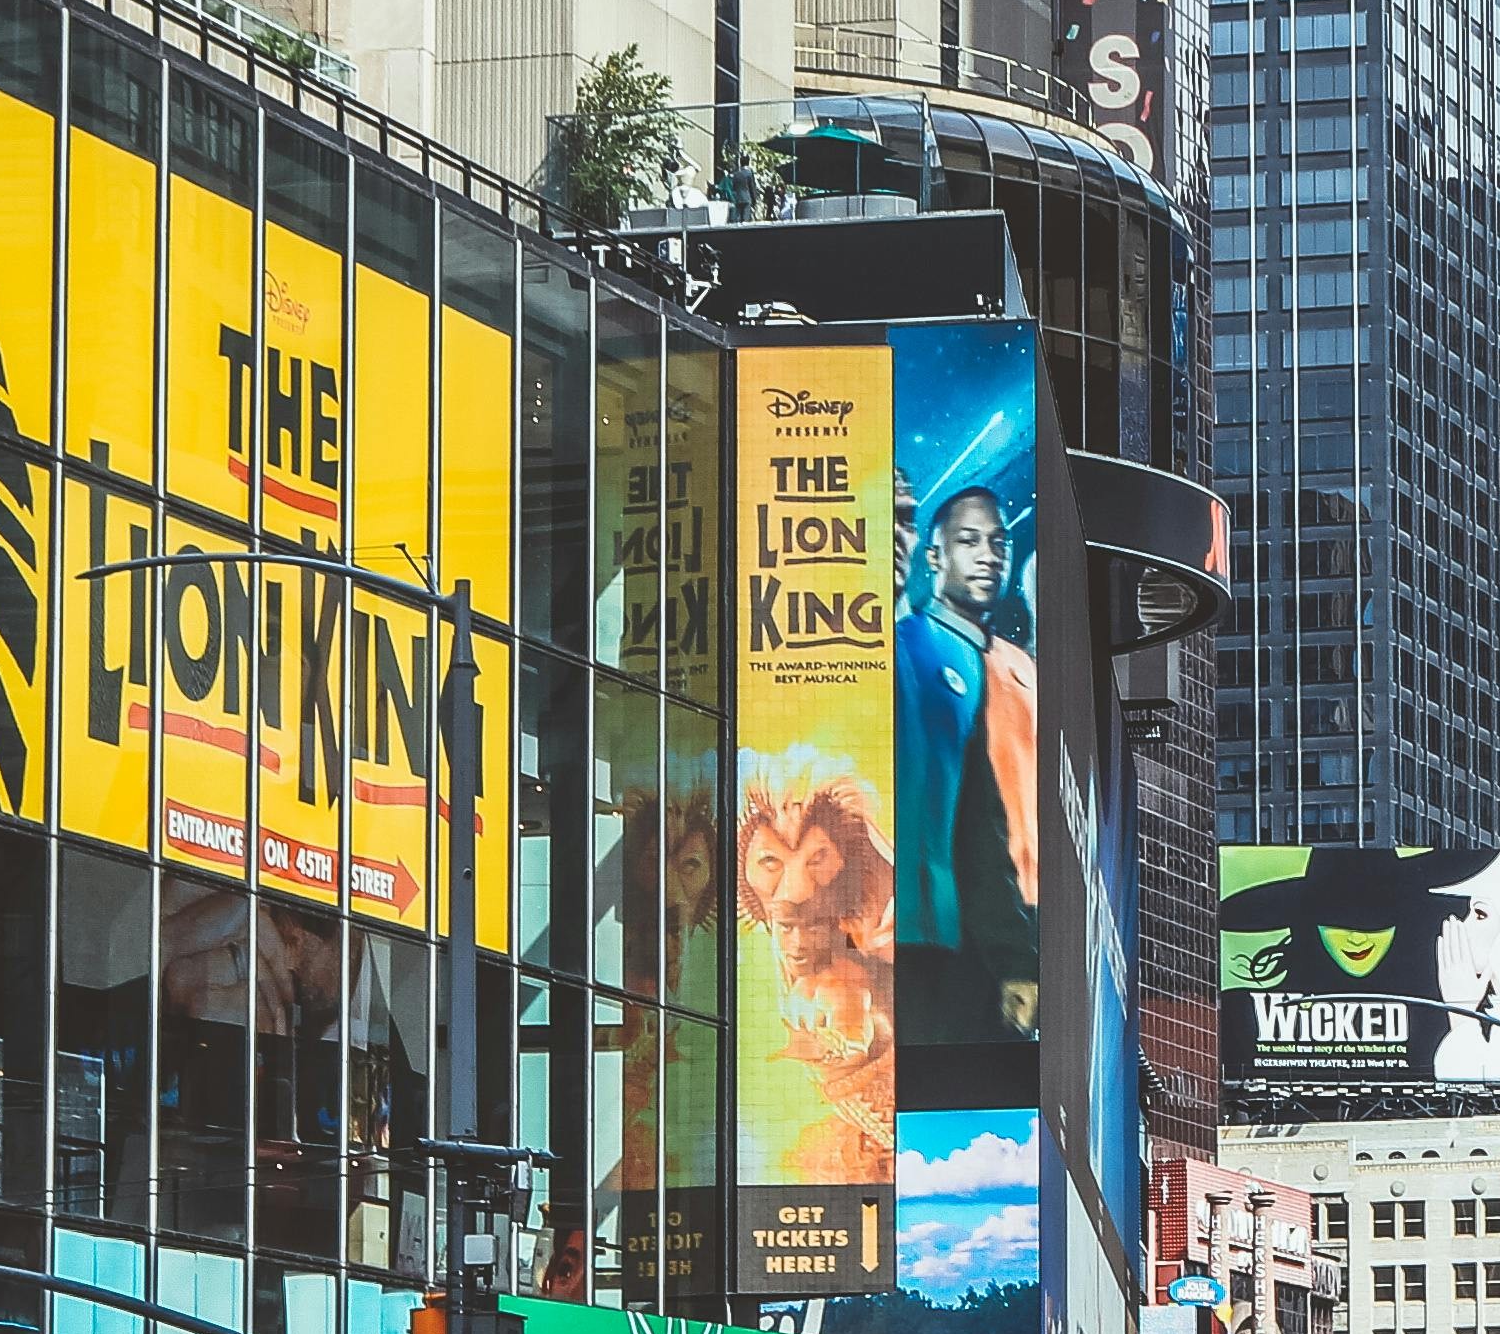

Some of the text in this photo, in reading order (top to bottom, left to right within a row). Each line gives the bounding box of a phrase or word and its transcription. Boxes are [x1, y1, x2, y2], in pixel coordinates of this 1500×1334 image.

[219, 323, 339, 489] THE
[762, 388, 854, 424] Disney
[776, 427, 848, 437] PRESENTS
[770, 457, 849, 492] THE
[757, 503, 866, 568] LION
[88, 440, 281, 746] LION
[750, 575, 883, 652] KING
[750, 661, 886, 671] THE AWARD-WINNING
[775, 674, 858, 683] BEST MUSICAL
[168, 809, 395, 902] ENTRANCE ON 45TH STREET
[1314, 1046, 1332, 1054] story
[1334, 1045, 1342, 1053] of
[1344, 1045, 1355, 1053] the
[1388, 1045, 1396, 1053] of
[778, 1207, 825, 1224] GET
[753, 1230, 849, 1247] TICKETS
[766, 1255, 835, 1273] HERE!
